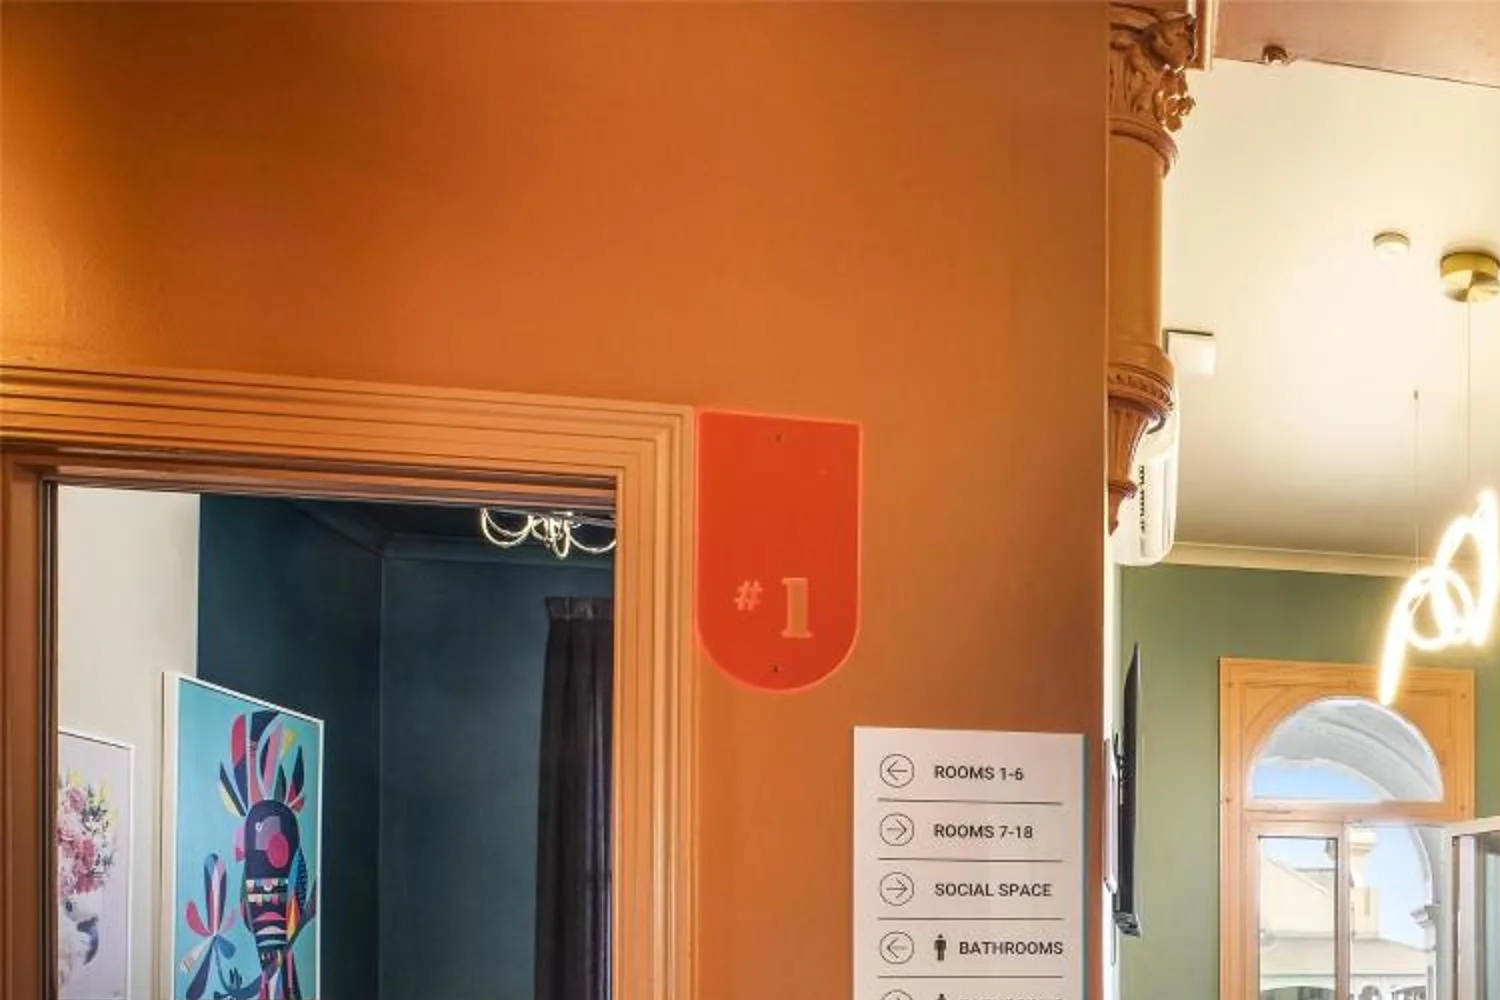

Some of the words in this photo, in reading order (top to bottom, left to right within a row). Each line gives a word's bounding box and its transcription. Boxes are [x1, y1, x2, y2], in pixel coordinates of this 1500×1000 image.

[933, 764, 995, 781] ROOMS
[999, 767, 1025, 782] 1-6
[933, 823, 995, 840] ROOMS
[998, 825, 1034, 840] 7-18
[933, 882, 994, 898] SOCIAL
[998, 882, 1053, 898] SPACE
[959, 940, 1065, 956] BATHROOMS
